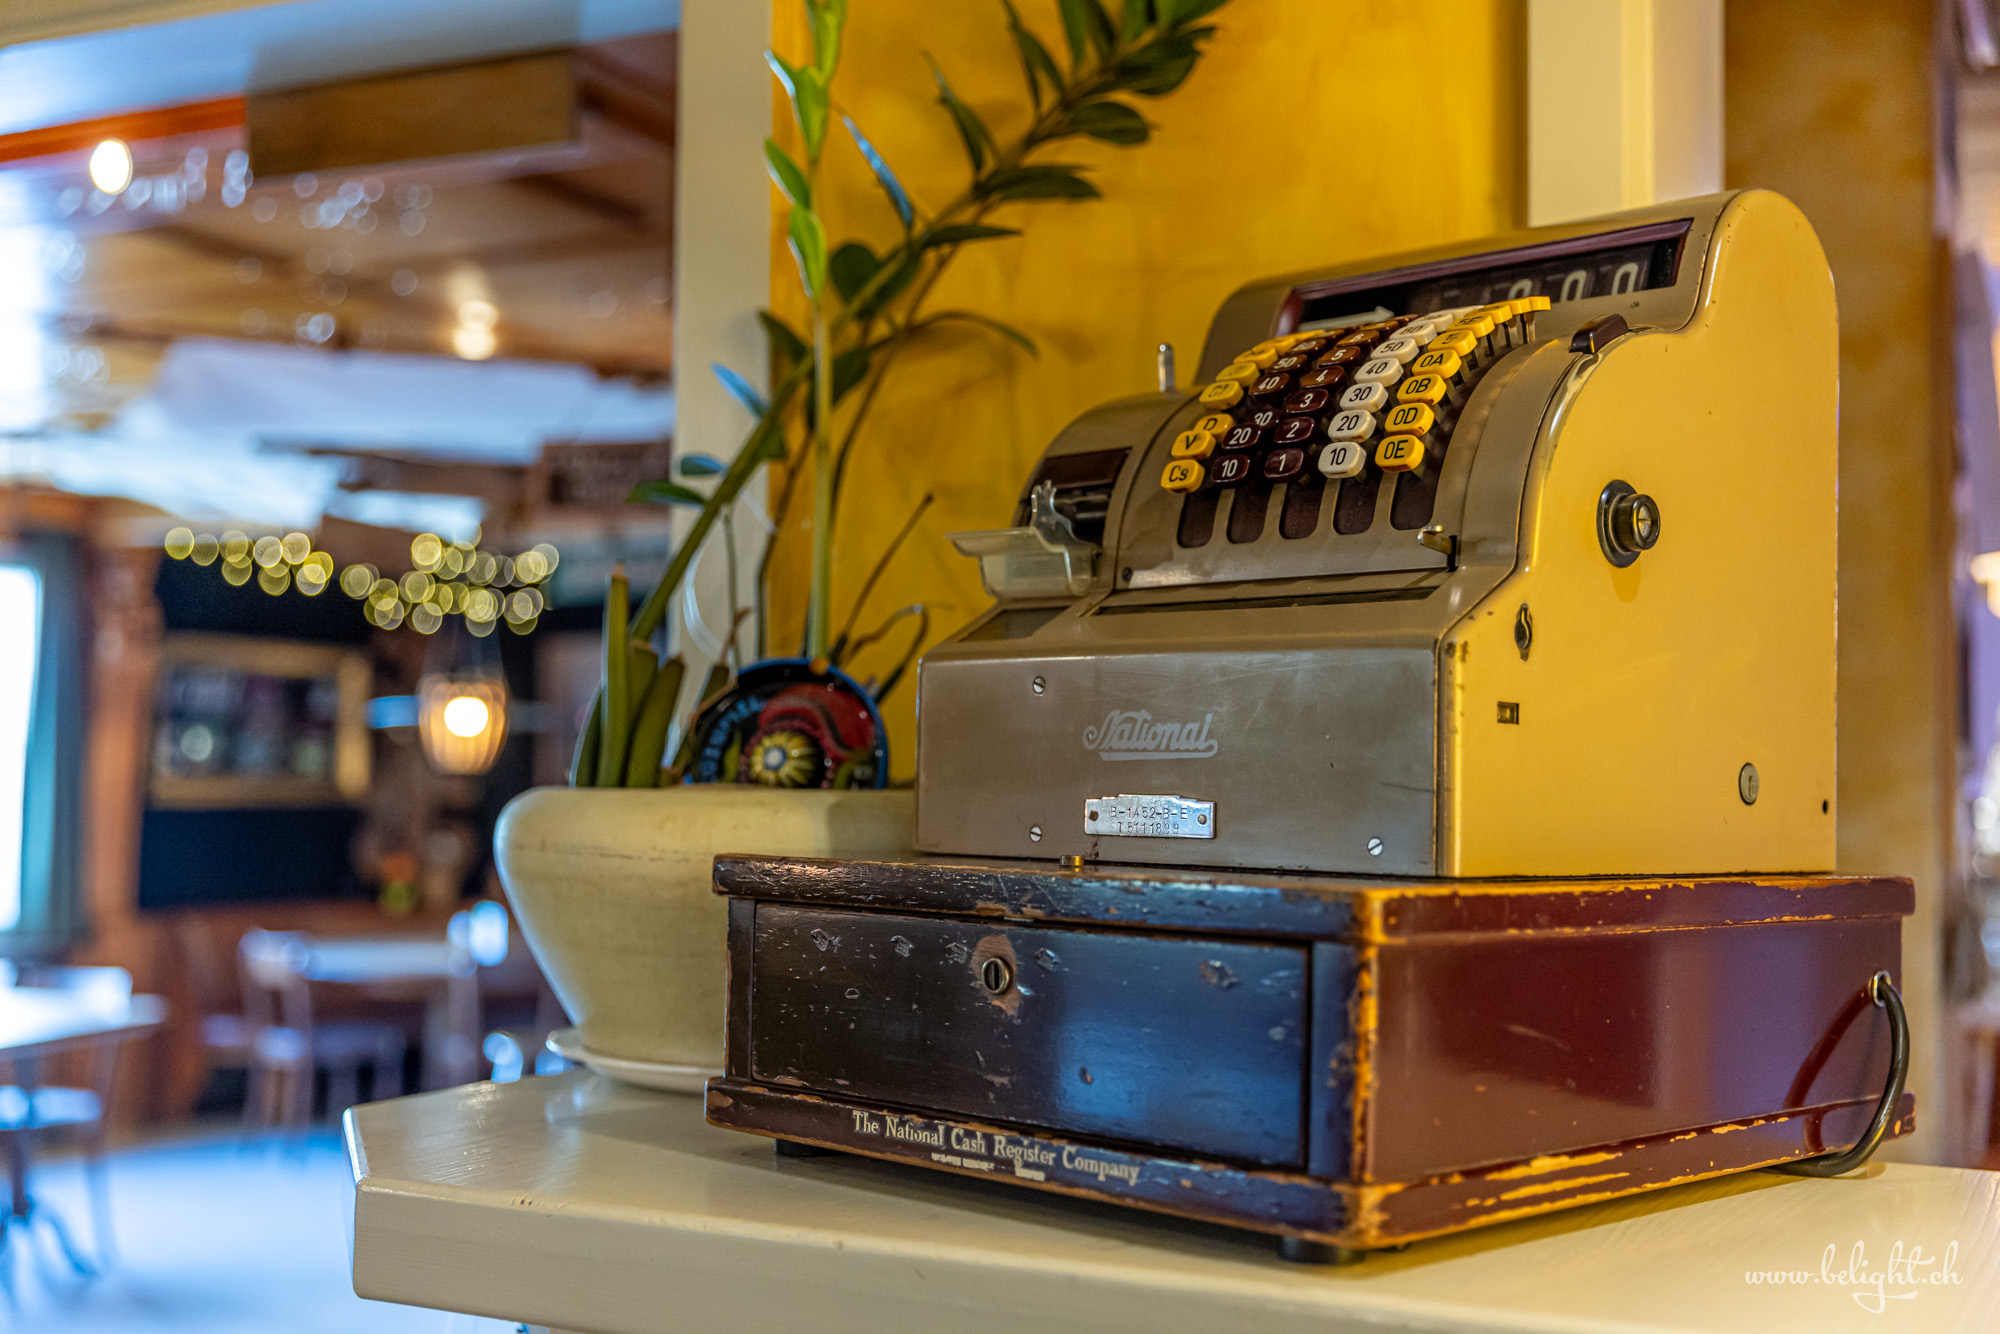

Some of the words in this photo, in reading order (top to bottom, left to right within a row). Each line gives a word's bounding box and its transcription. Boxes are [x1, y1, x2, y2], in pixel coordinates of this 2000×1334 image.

[1331, 349, 1347, 361] 5
[1380, 341, 1404, 354] 50
[1274, 356, 1298, 369] 50
[1366, 362, 1388, 376] 40
[1257, 376, 1280, 391] 40
[1315, 369, 1328, 383] 4
[1299, 393, 1314, 408] 3
[1349, 387, 1372, 402] 30
[1203, 417, 1218, 431] D
[1253, 411, 1273, 426] 30
[1336, 414, 1360, 432] 20
[1228, 427, 1252, 444] 20
[1285, 421, 1300, 438] 2
[1184, 434, 1198, 450] V
[1279, 453, 1287, 471] 1
[1330, 447, 1347, 466] 10
[1168, 464, 1190, 483] Cs
[1221, 459, 1239, 478] 10
[1082, 709, 1218, 761] National
[852, 1110, 879, 1134] The
[885, 1115, 944, 1146] National
[951, 1127, 985, 1153] Cash
[993, 1135, 1055, 1168] Register
[1062, 1144, 1141, 1187] Company
